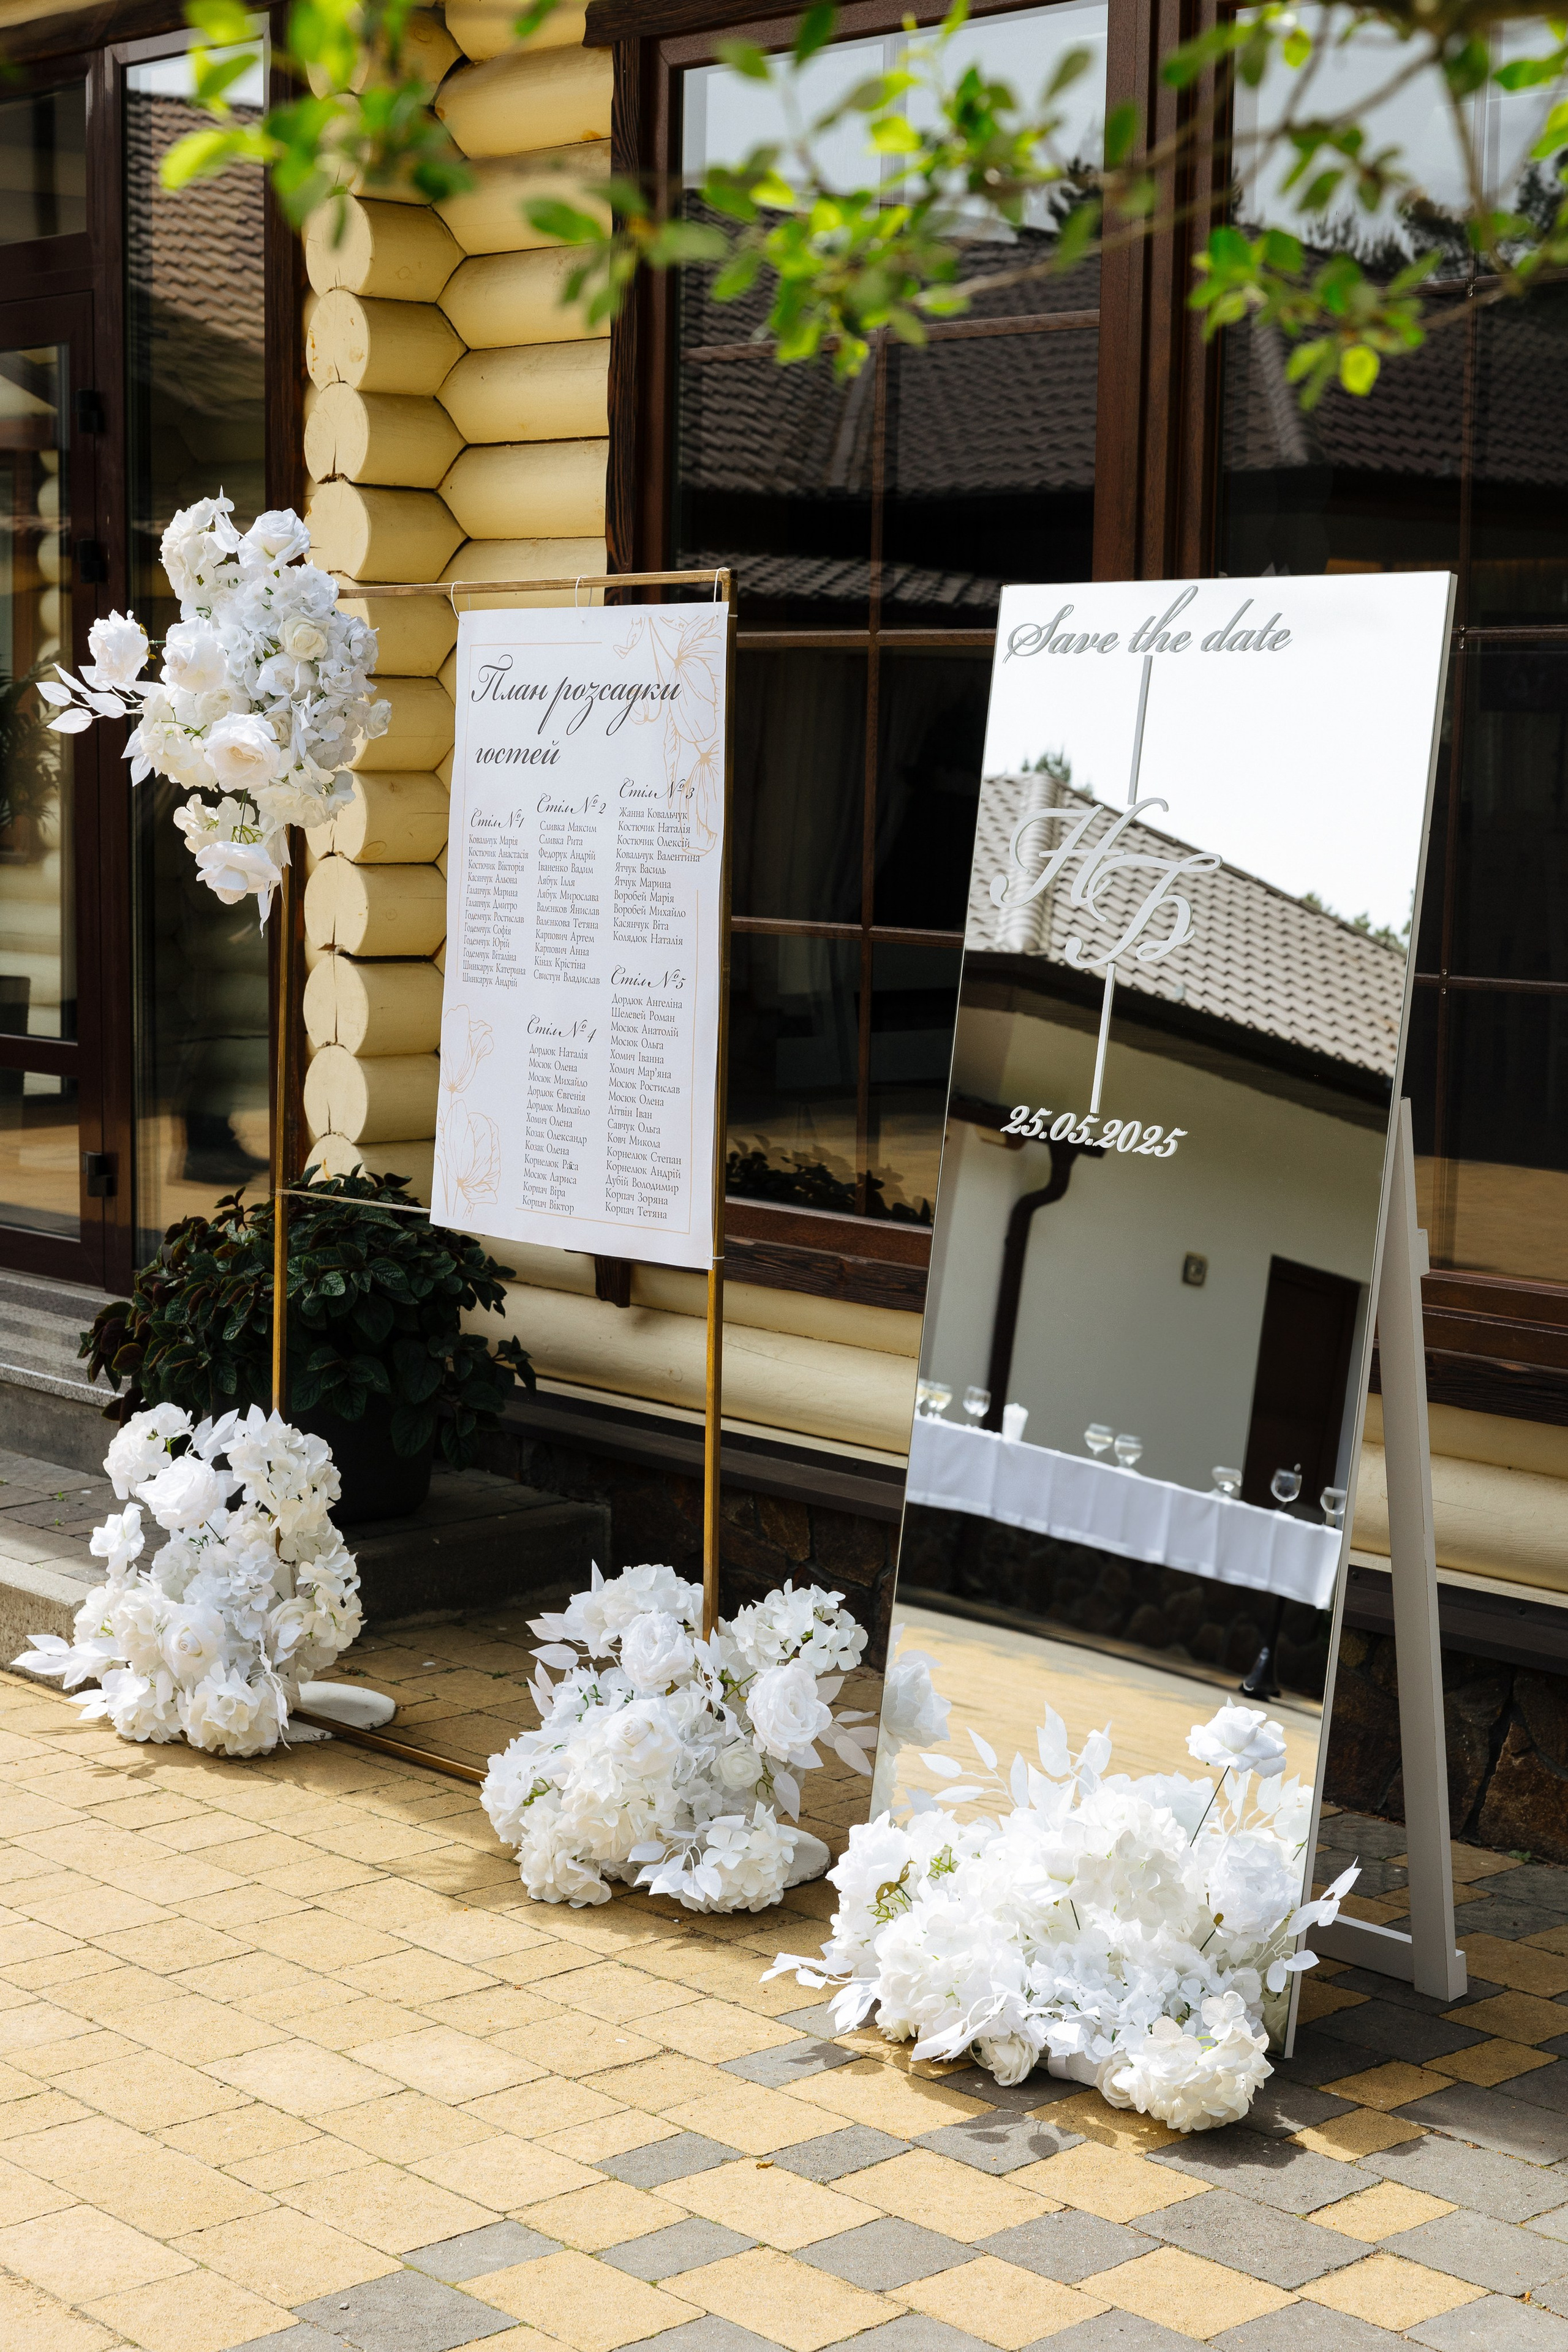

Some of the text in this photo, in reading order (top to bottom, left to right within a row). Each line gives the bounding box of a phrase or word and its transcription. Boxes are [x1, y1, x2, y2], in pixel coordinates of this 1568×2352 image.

[1002, 585, 1293, 664] Save the date
[471, 654, 682, 736] План розсадки
[475, 741, 561, 764] гостей
[619, 777, 654, 798] Стіл
[537, 793, 569, 813] Стіл
[470, 808, 497, 827] Стіл
[619, 807, 688, 822] Жанна Ковальчук
[540, 821, 597, 832] Сливка Максим
[618, 821, 690, 834] Костючик Наталія
[469, 834, 518, 848] Ковальчук Марія
[539, 834, 583, 845] Сливка Рита
[617, 835, 690, 847] Костючик Олексій
[469, 847, 529, 859] Костючик Анастасія
[538, 848, 596, 862] Федорук Андрій
[616, 848, 700, 862] Ковальчук Валентина
[468, 859, 524, 874] Костючик Вікторія
[538, 862, 594, 874] Іваненко Вадим
[615, 862, 666, 875] Ятчук Василь
[468, 872, 518, 885] Касянчук Альона
[560, 876, 575, 886] Ілля
[614, 876, 671, 890] Ятчук Марина
[493, 886, 518, 899] Марина
[560, 890, 599, 903] Мирослава
[614, 889, 674, 905] Воробей Марія
[492, 899, 518, 912] Дмитро
[570, 904, 600, 916] Янислав
[614, 903, 686, 918] Воробей Михайло
[465, 910, 524, 923] Годемчук Ростислав
[573, 918, 598, 929] Тетяна
[464, 922, 511, 937] Годемчук Софія
[613, 918, 669, 932] Касянчук Віта
[464, 935, 510, 950] Годемчук Юрій
[535, 929, 595, 944] Карпович Артем
[613, 931, 683, 945] Колядюк Наталія
[463, 948, 517, 961] Годемчук Віталіна
[535, 943, 589, 956] Карпович Анна
[463, 960, 526, 976] Шинкарук Катерина
[535, 956, 586, 970] Кінах Крістіна
[462, 973, 518, 989] Шинкарук Андрій
[533, 969, 600, 984] Свистун Владислав
[611, 965, 647, 986] Стіл
[611, 993, 682, 1009] Дордюк Ангеліна
[611, 1007, 675, 1022] Шелевей Роман
[527, 1014, 557, 1035] Стіл
[611, 1021, 679, 1037] Мосюк Анатолій
[611, 1035, 664, 1050] Мосюк Ольга
[529, 1044, 588, 1059] Дордюк Наталія
[610, 1049, 664, 1064] Хомич Іванна
[529, 1058, 578, 1072] Мосюк Олена
[609, 1063, 635, 1075] Хомич
[528, 1071, 588, 1087] Мосюк Михайло
[609, 1077, 680, 1094] Мосюк Ростислав
[527, 1085, 586, 1101] Дордюк Євгенія
[608, 1091, 664, 1106] Мосюк Олена
[527, 1099, 590, 1116] Дордюк Михайло
[608, 1105, 652, 1118] Літвін Іван
[526, 1113, 573, 1128] Хомич Олена
[608, 1118, 660, 1134] Савчук Ольга
[526, 1126, 587, 1147] Козак Олександр
[1000, 1105, 1188, 1157] 25.05.2025
[525, 1140, 569, 1155] Козак Олена
[629, 1135, 660, 1148] Микола
[524, 1154, 559, 1168] Корнелюк
[607, 1147, 681, 1164] Корнелюк Степан
[524, 1168, 577, 1185] Мосюк Лариса
[606, 1160, 681, 1180] Корнелюк Андрій
[523, 1182, 565, 1199] Корпач Віра
[605, 1175, 679, 1195] Дубій Володимир
[605, 1188, 668, 1206] Корпач Зоряна
[522, 1195, 575, 1215] Корпач Віктор
[605, 1202, 667, 1219] Корпач Тетяна
